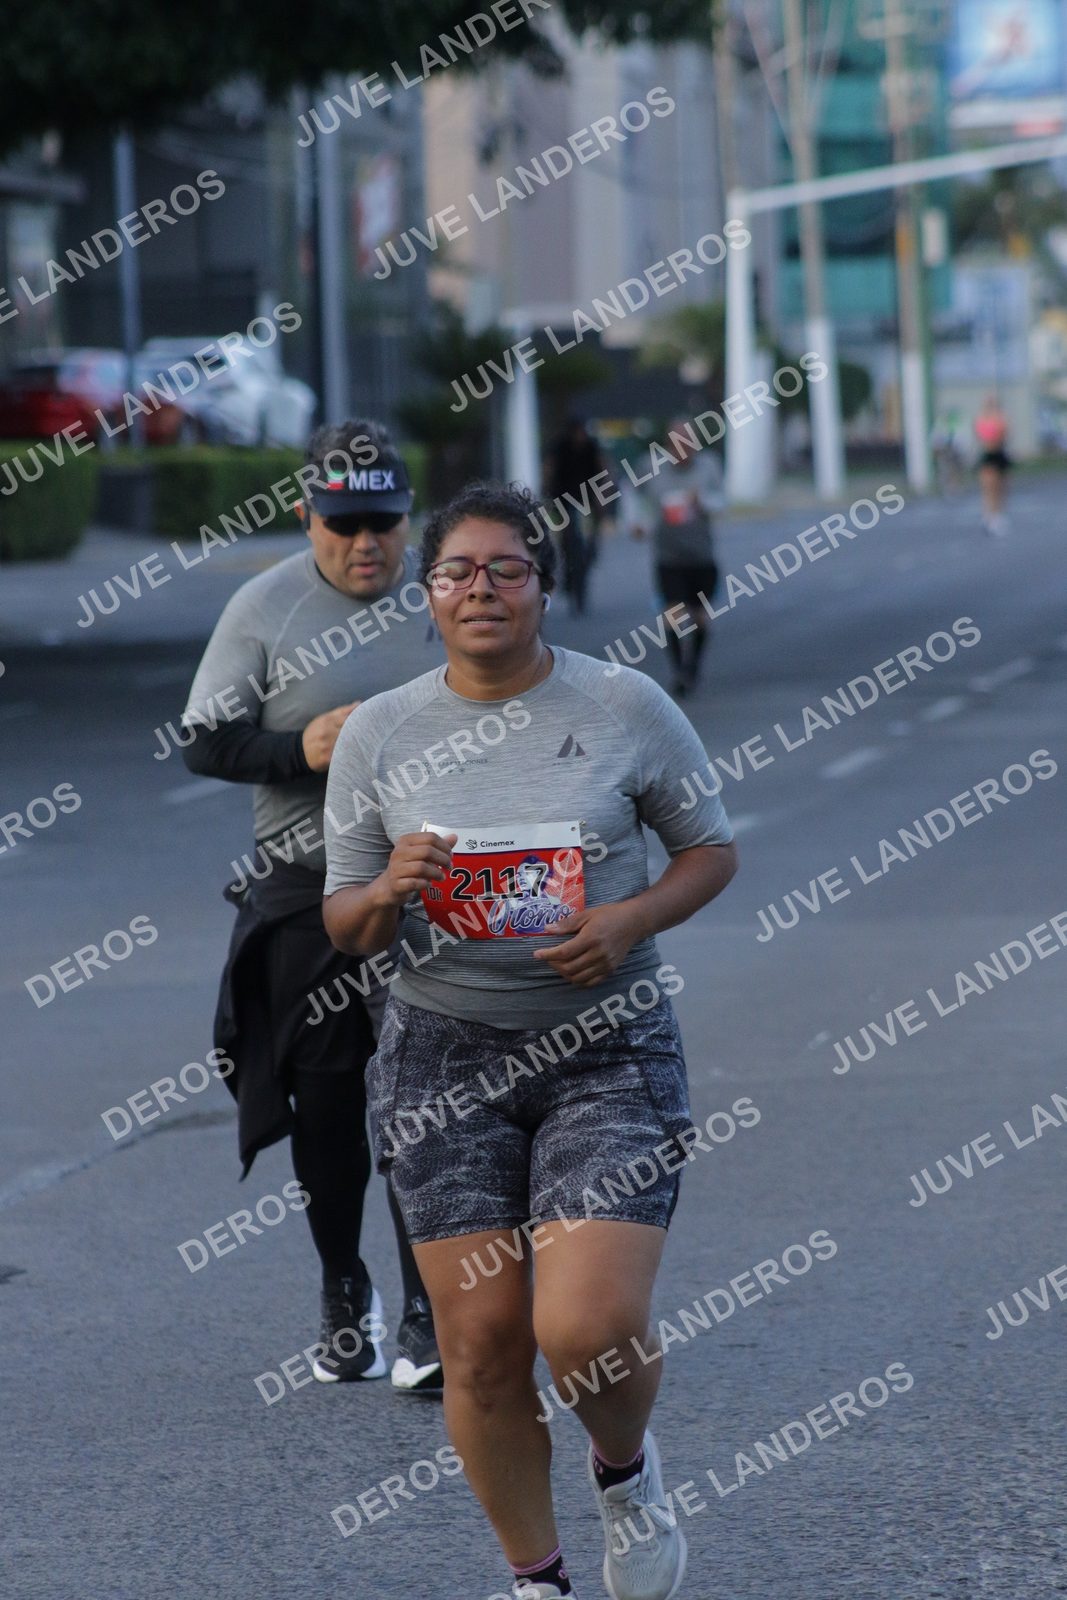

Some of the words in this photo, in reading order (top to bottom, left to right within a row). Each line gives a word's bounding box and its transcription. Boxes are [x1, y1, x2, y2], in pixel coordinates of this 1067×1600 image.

[348, 469, 395, 490] MEX
[480, 839, 515, 848] Cinemex
[450, 864, 549, 901] 2117
